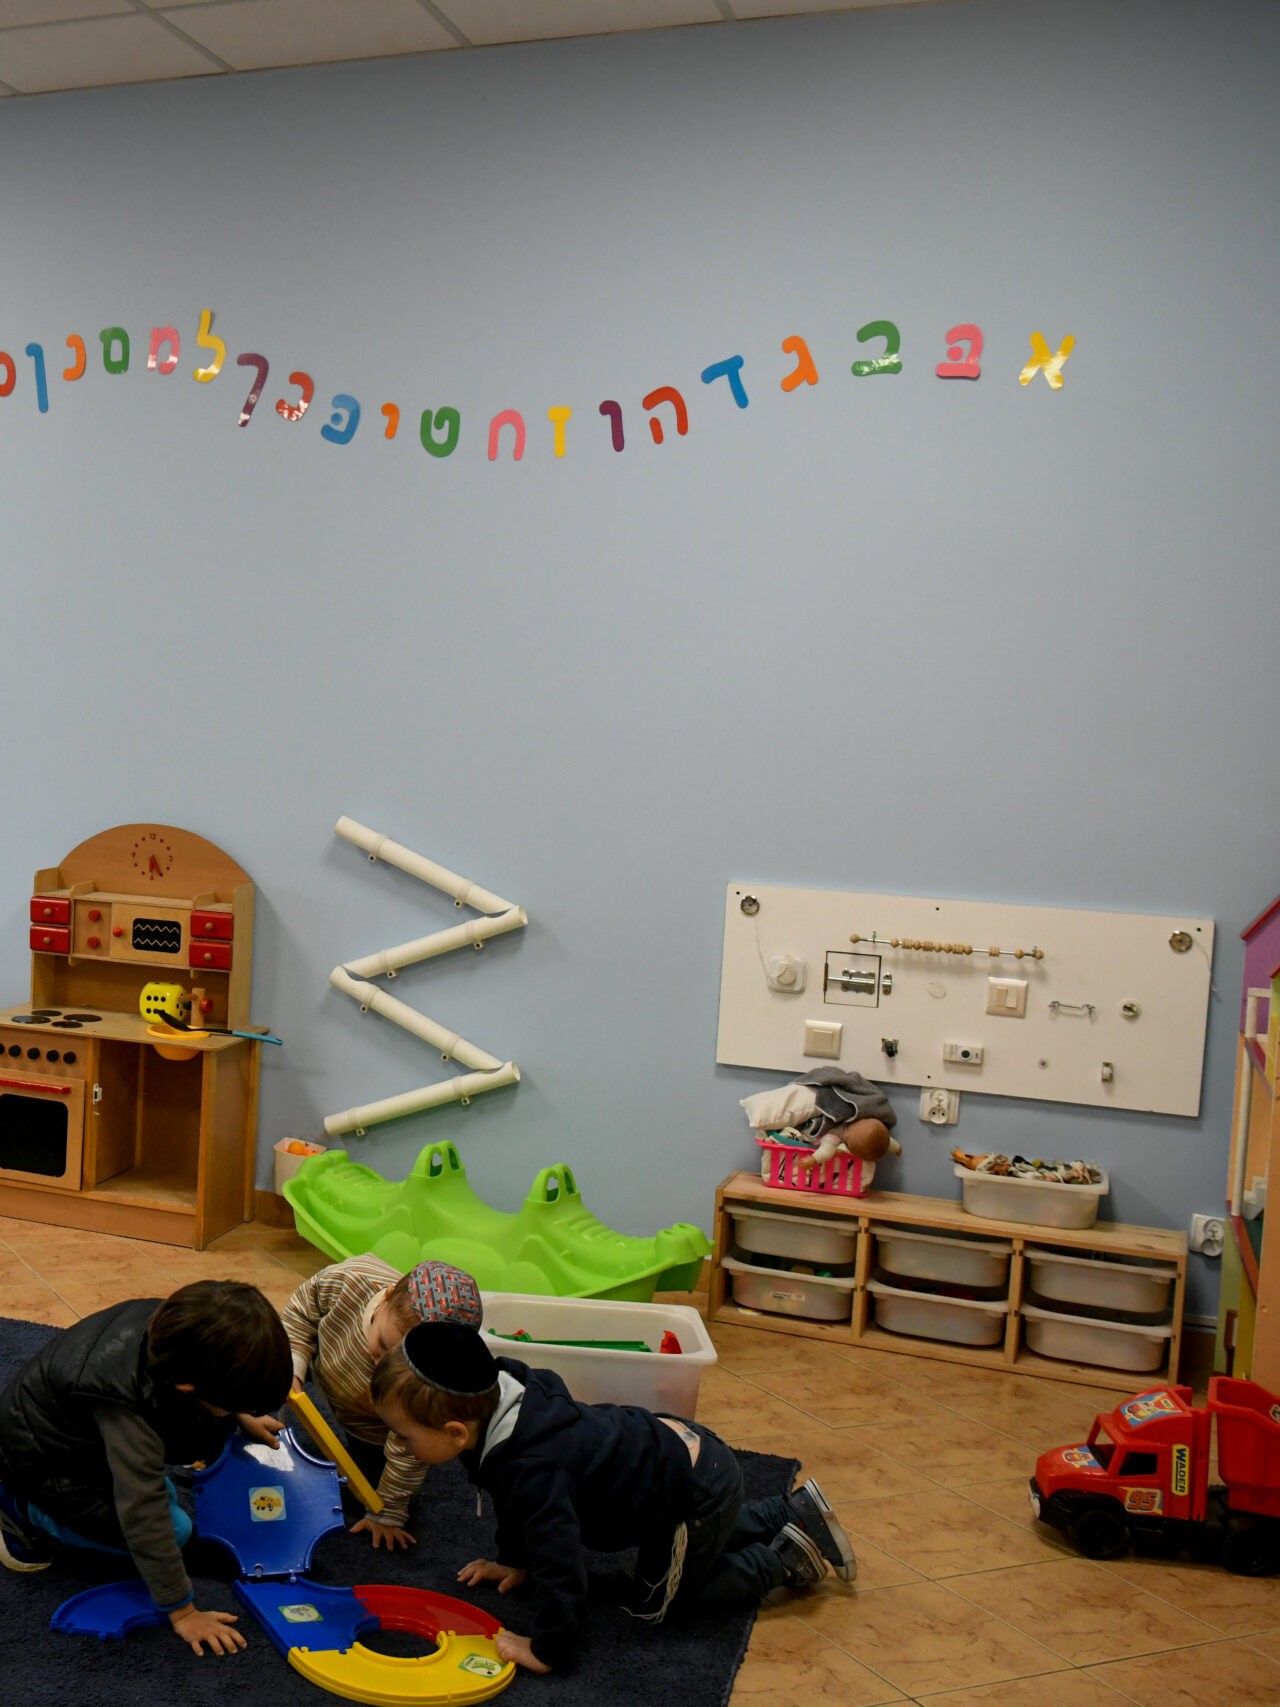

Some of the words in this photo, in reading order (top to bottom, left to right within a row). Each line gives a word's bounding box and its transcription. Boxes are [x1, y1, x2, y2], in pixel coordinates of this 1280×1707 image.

[62, 333, 87, 382] נ
[147, 326, 180, 375] מ
[192, 308, 227, 383] ל
[780, 335, 819, 392] ג
[851, 319, 904, 377] ב
[1018, 329, 1077, 391] א
[25, 342, 49, 413] ן
[701, 355, 749, 409] ד
[420, 405, 461, 458] ט
[487, 408, 527, 461] ח
[546, 405, 573, 458] ז
[600, 400, 624, 452] ו
[642, 386, 689, 445] ה
[1176, 1448, 1186, 1493] WADER
[1126, 1490, 1158, 1511] 95
